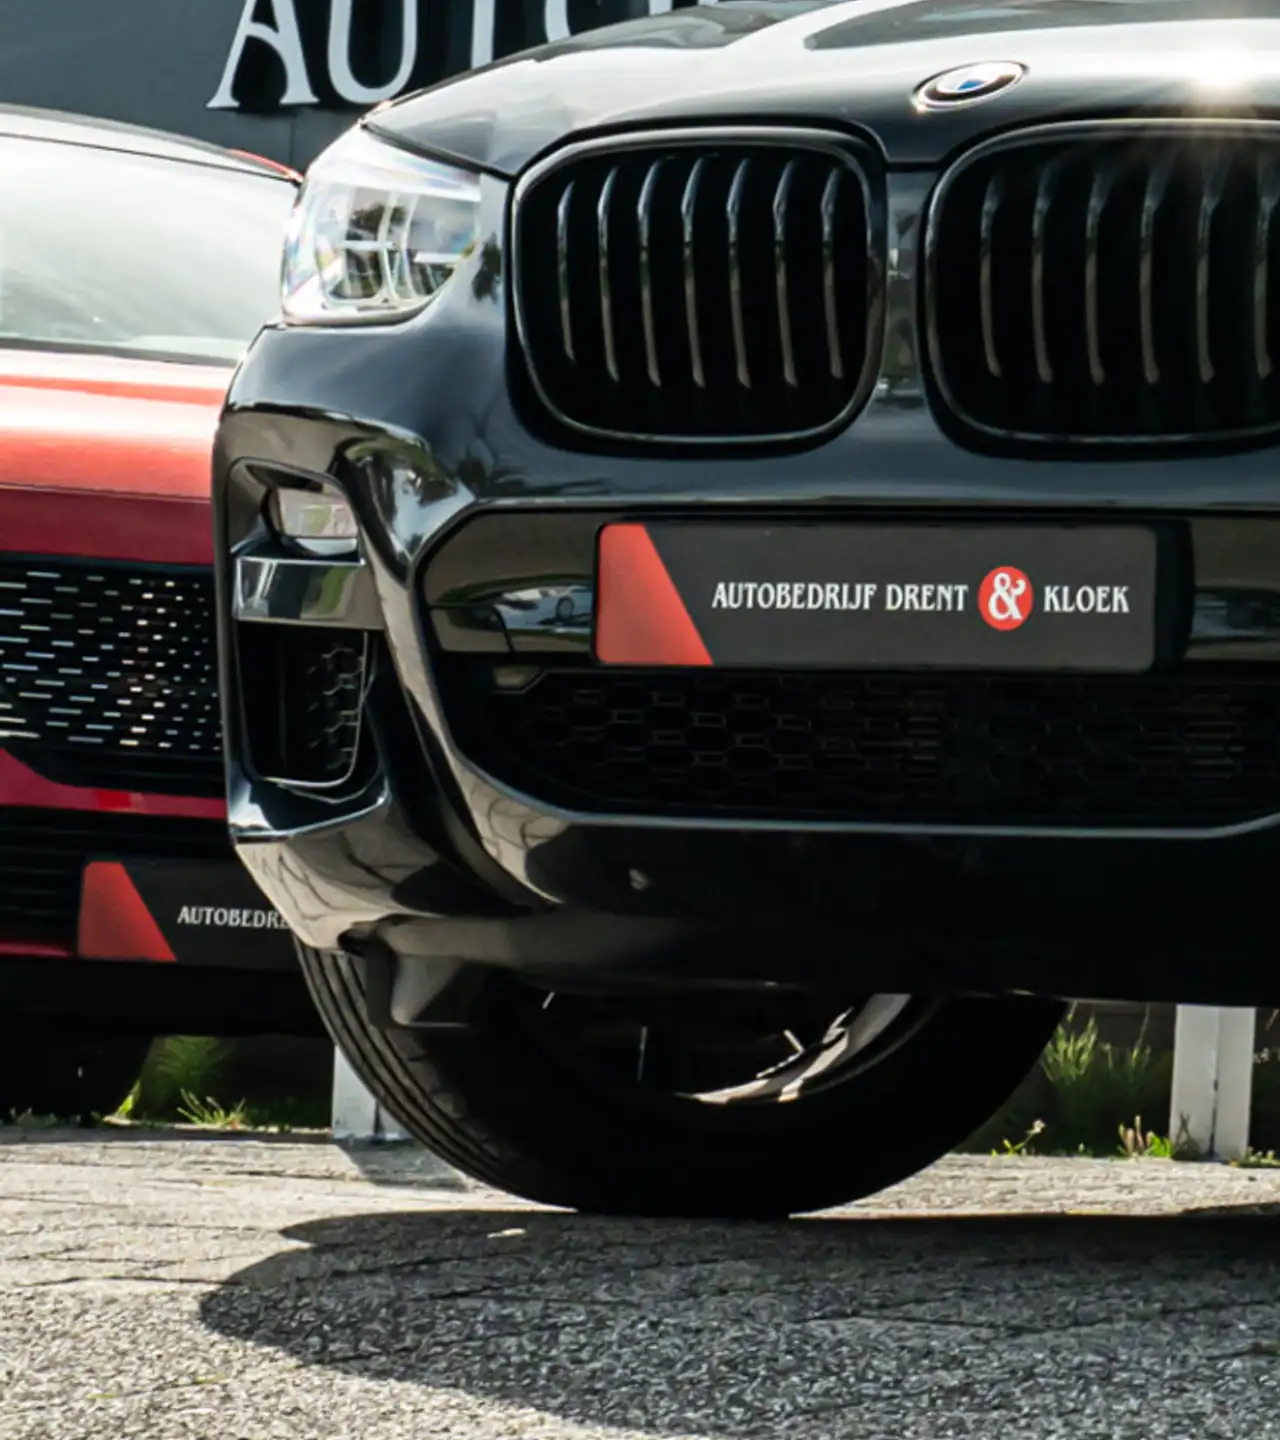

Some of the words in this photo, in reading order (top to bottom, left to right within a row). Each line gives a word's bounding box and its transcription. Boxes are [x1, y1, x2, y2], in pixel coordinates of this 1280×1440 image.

[712, 582, 877, 610] AUTOBEDRIJF
[886, 583, 969, 611] DRENT
[988, 572, 1026, 620] &
[1044, 586, 1129, 613] KLOEK
